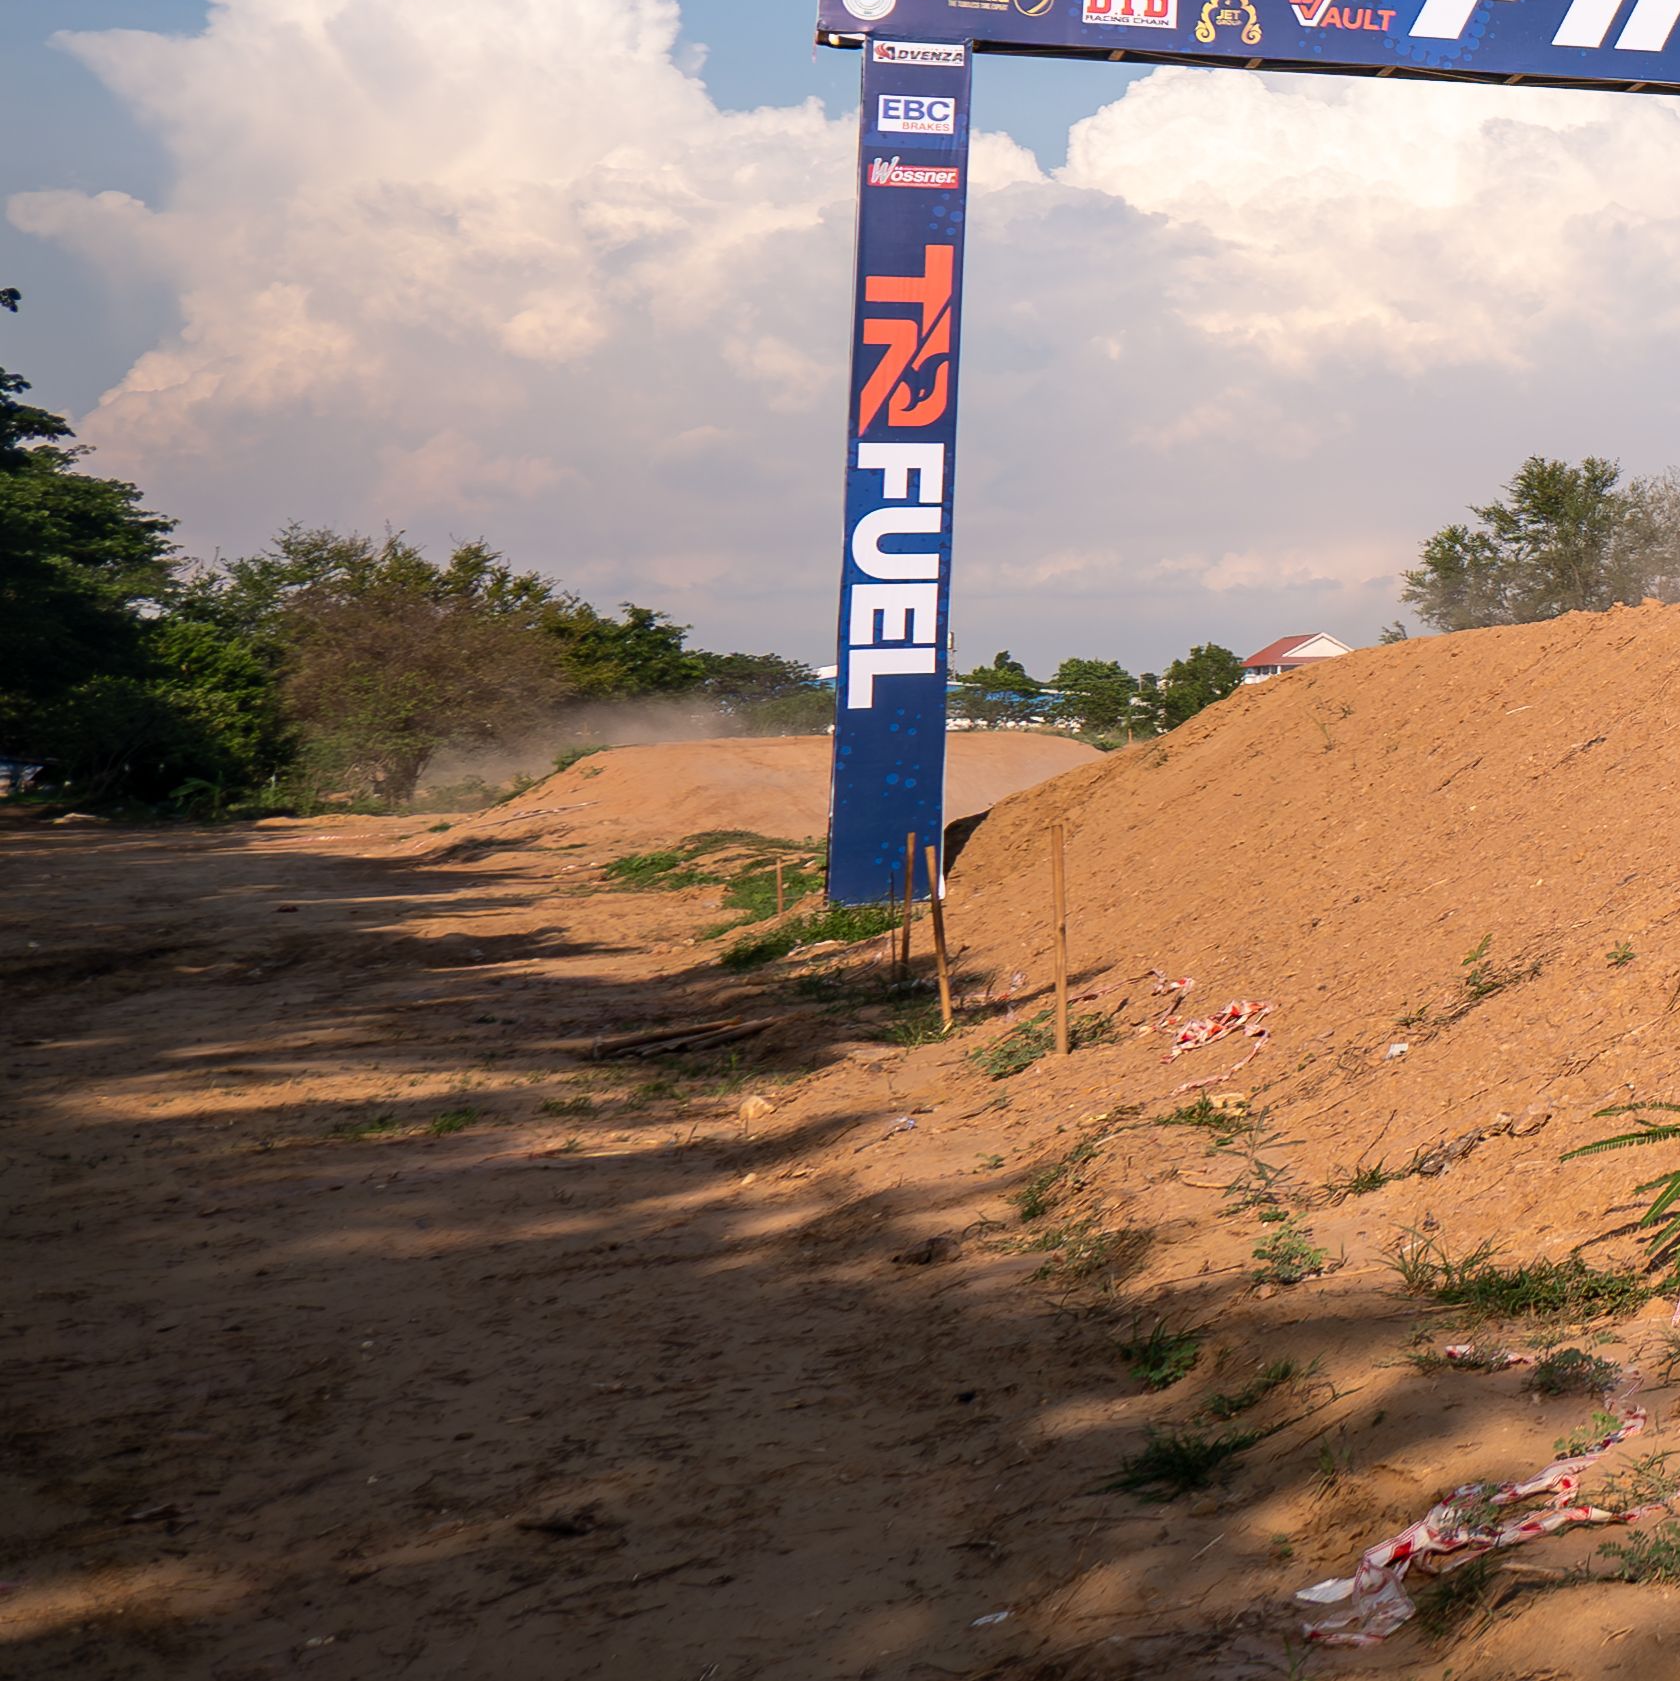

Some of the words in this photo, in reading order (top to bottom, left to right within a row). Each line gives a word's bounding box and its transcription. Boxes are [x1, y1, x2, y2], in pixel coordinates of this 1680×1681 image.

[1085, 15, 1130, 24] RACING
[1133, 17, 1170, 26] CHAIN
[1216, 9, 1242, 20] JET
[875, 43, 963, 62] ADVENZA
[882, 99, 950, 121] EBC
[902, 122, 950, 132] BRAKES
[871, 156, 955, 184] Wössner
